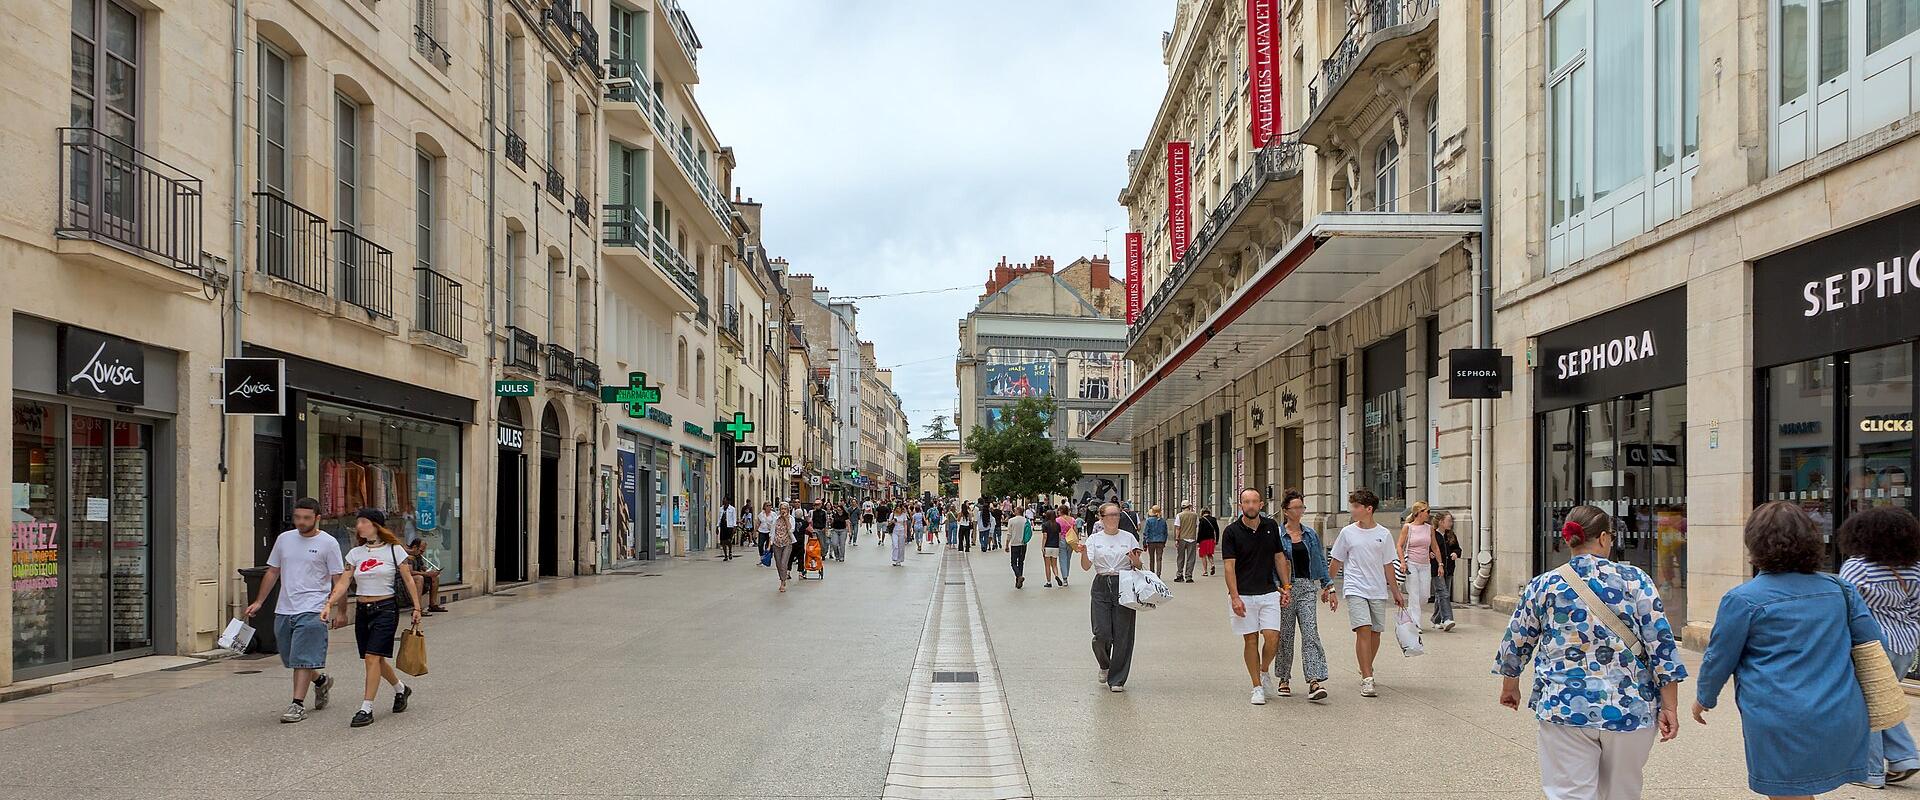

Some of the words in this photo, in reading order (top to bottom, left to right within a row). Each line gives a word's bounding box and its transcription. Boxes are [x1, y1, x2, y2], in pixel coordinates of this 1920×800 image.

[1259, 69, 1273, 143] GALERIES
[1174, 148, 1184, 207] LAFAYETTE
[1174, 209, 1185, 260] GALERIES
[1130, 237, 1138, 284] LAFAYETTE
[1130, 285, 1139, 323] GALERIES
[71, 341, 141, 393] Lovisa
[1557, 330, 1655, 380] SEPHORA
[229, 376, 275, 398] Lovisa
[497, 384, 529, 393] JULES
[497, 426, 523, 449] JULES
[737, 450, 756, 464] JD
[13, 562, 58, 577] OMPOSITION
